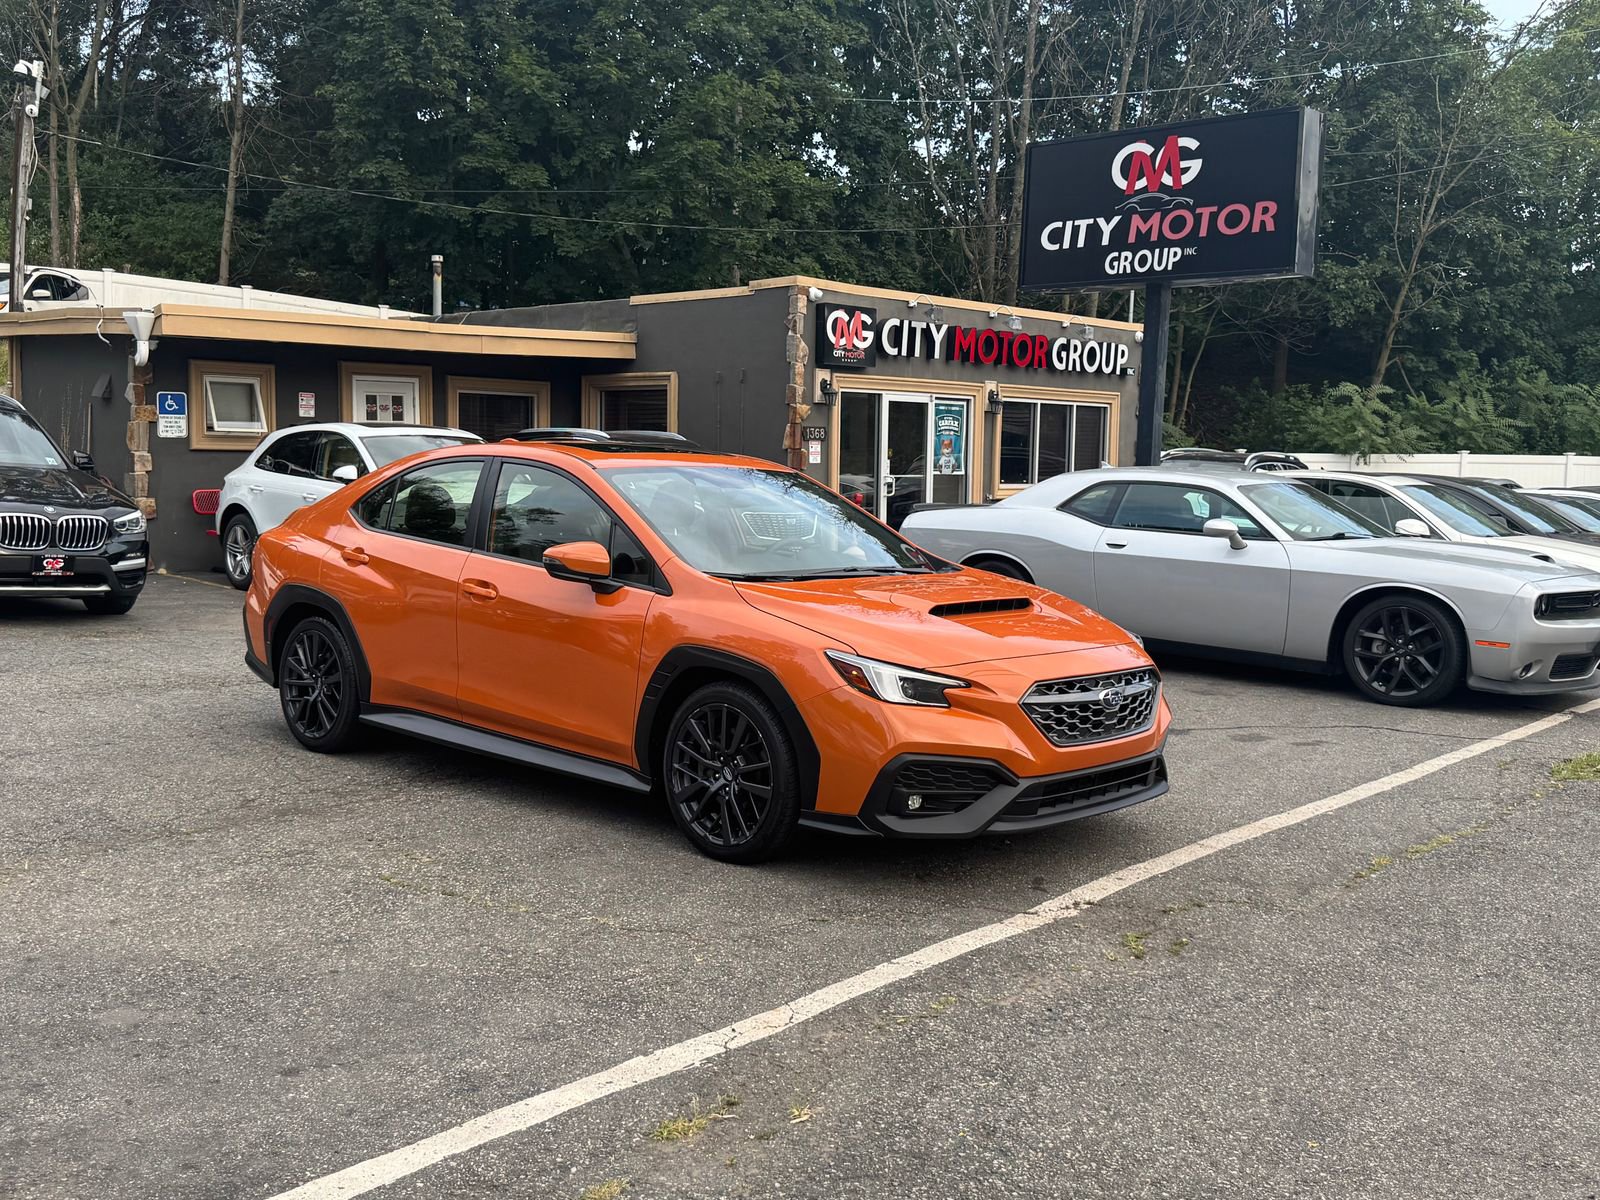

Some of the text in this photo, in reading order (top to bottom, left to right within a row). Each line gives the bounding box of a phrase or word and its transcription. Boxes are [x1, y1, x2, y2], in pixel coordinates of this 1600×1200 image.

[1040, 201, 1278, 251] CITY MOTOR
[1104, 246, 1198, 274] GROUP INC
[881, 317, 949, 359] CITY
[953, 325, 1049, 369] MOTOR
[1052, 336, 1129, 376] GROUP
[806, 427, 825, 439] 1368
